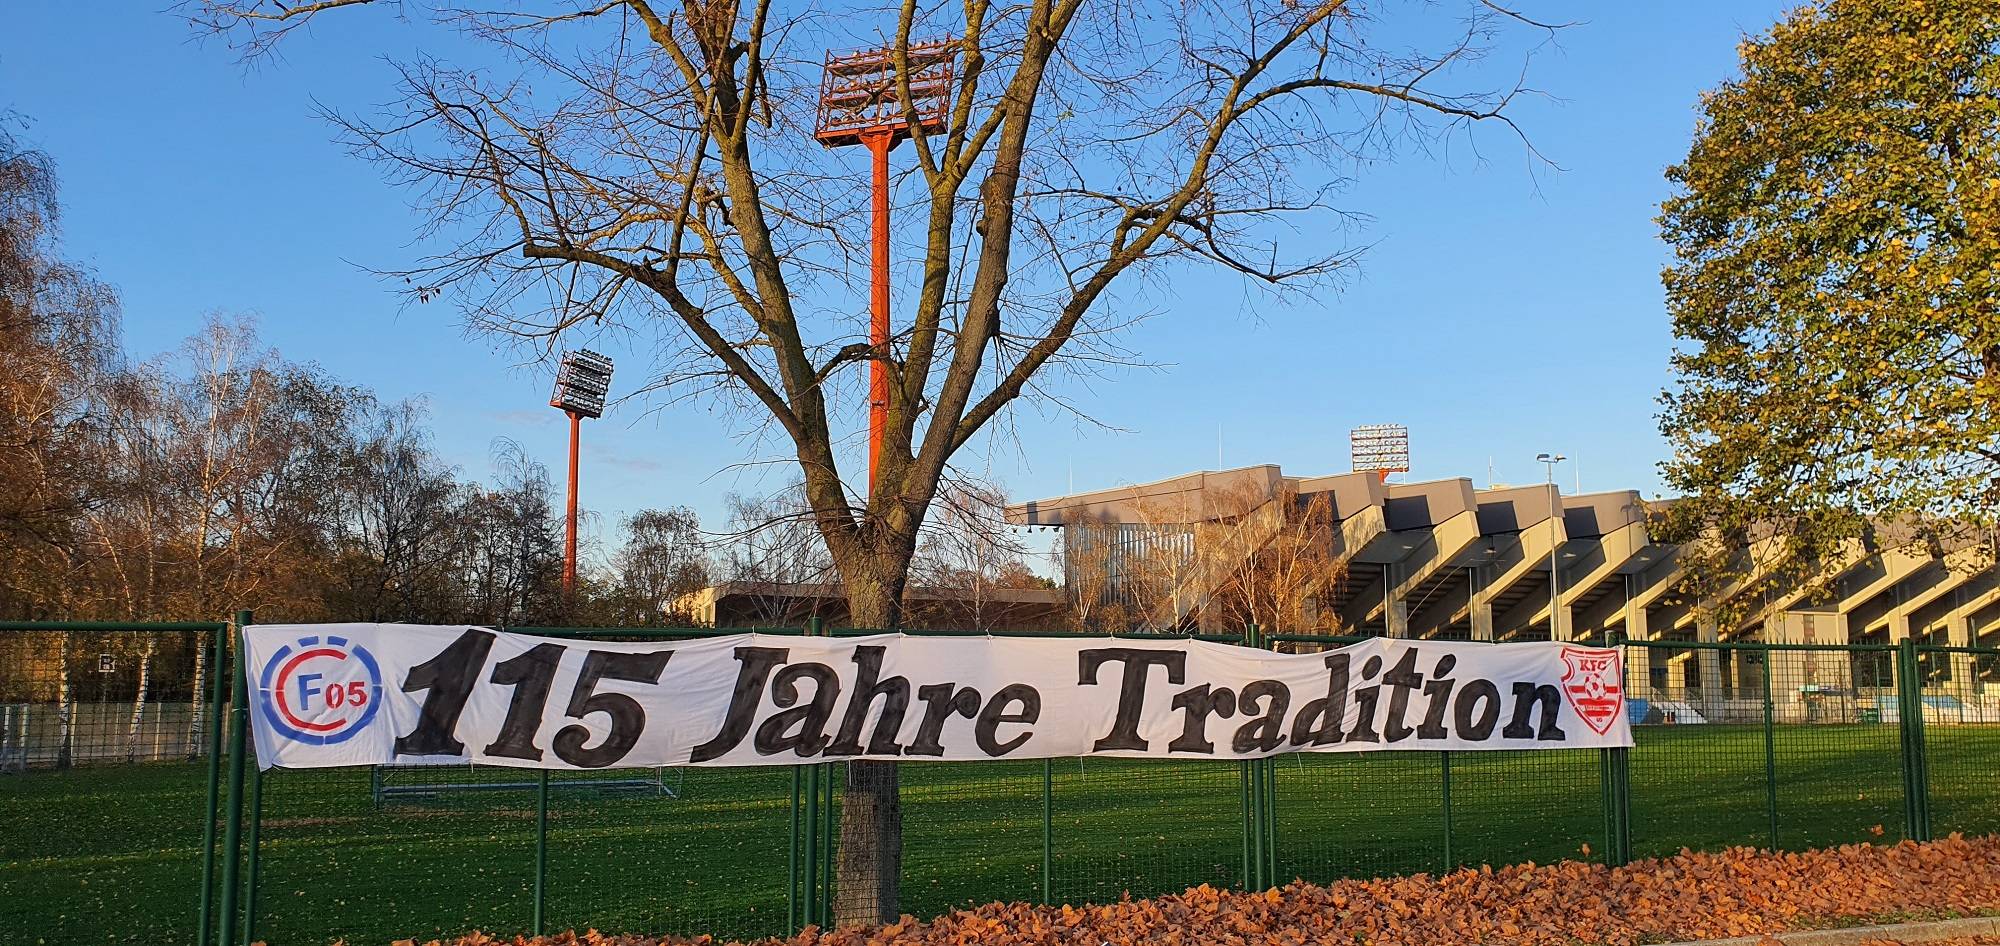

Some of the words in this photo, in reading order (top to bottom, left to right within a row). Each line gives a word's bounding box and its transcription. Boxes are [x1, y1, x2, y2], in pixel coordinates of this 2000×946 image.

[393, 628, 676, 769] 115
[689, 645, 1042, 763] Jahre
[1078, 647, 1566, 754] Tradition
[1579, 659, 1607, 672] KFC
